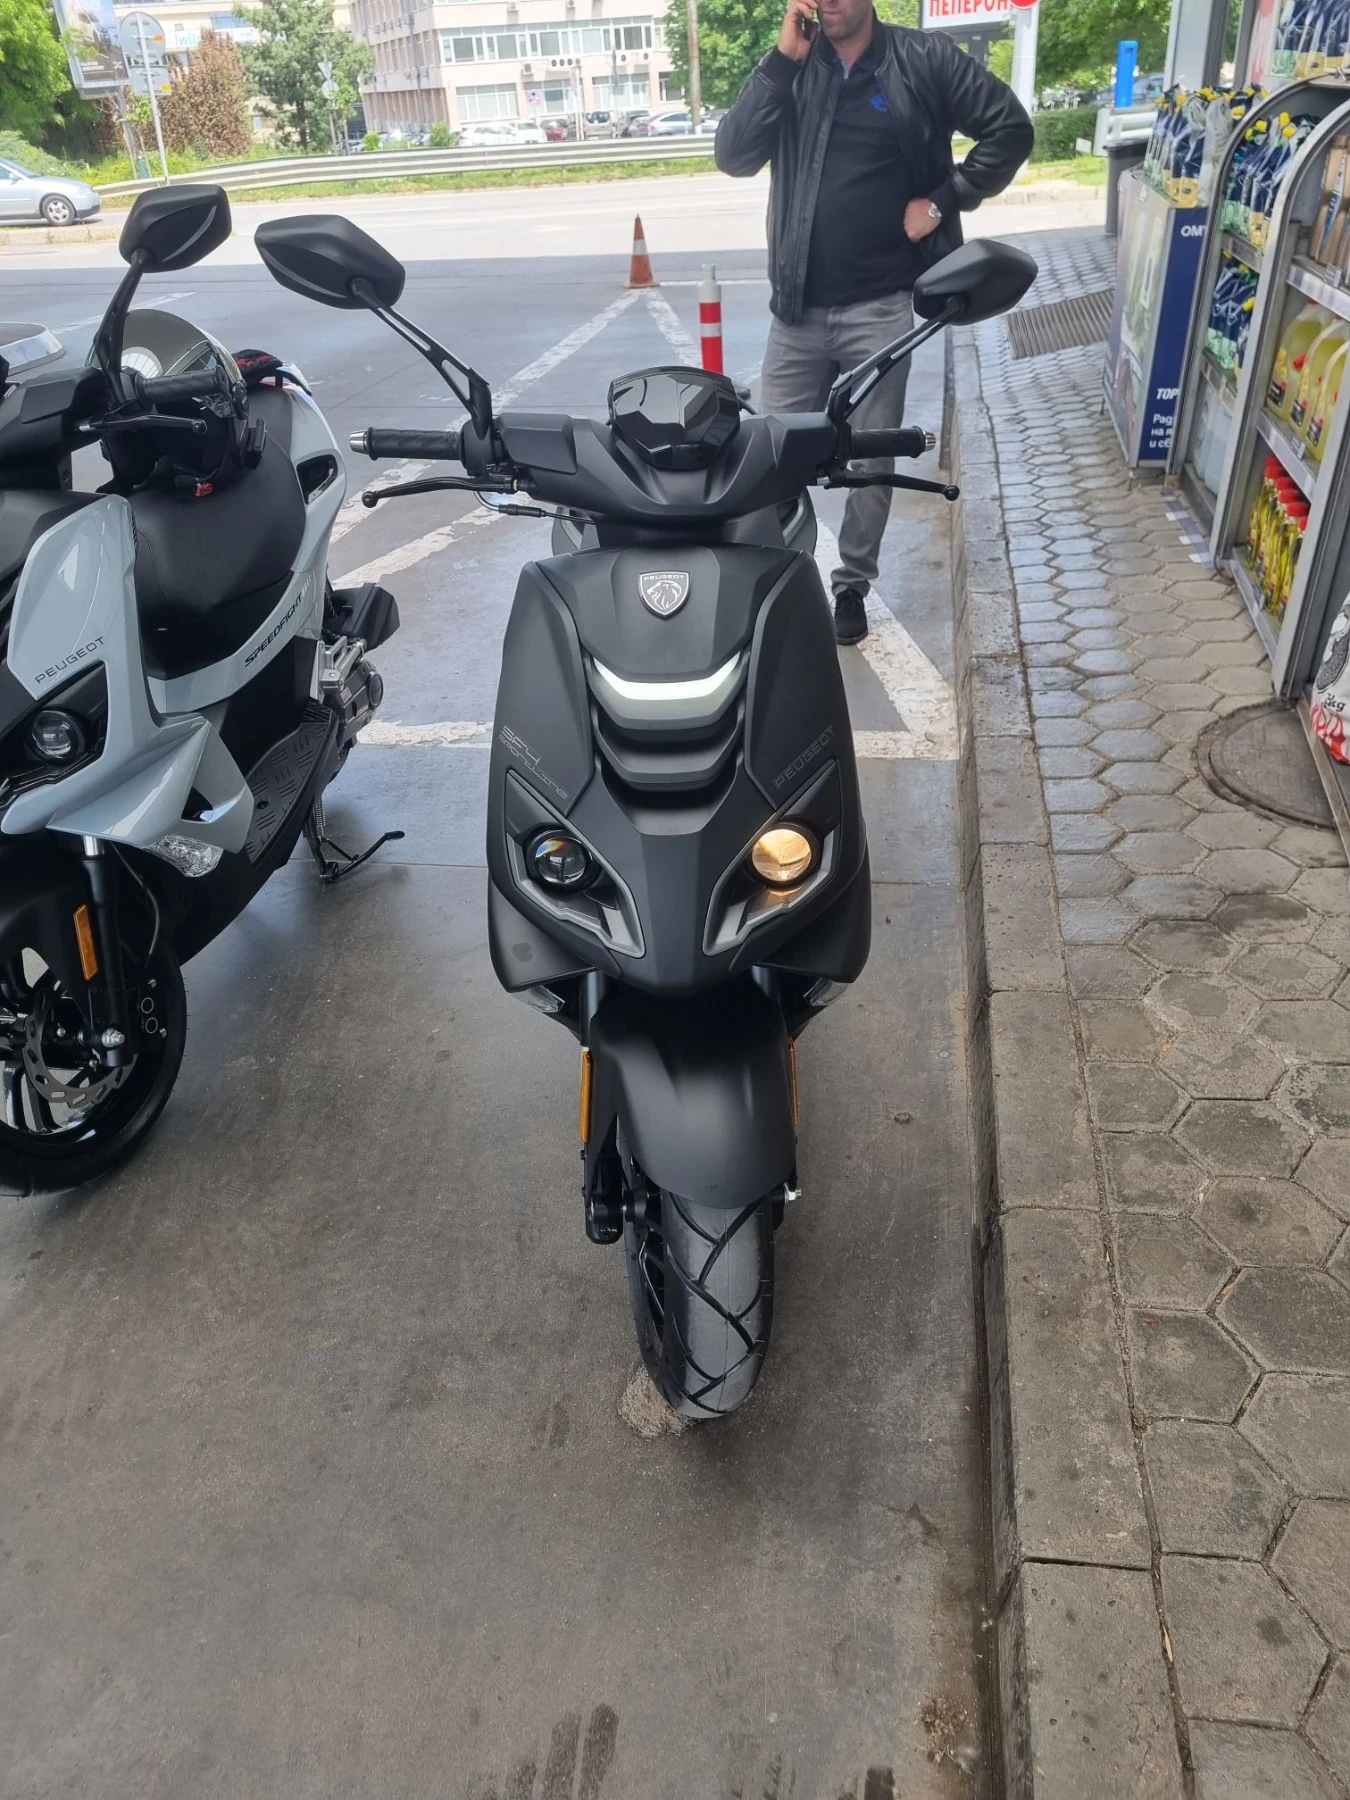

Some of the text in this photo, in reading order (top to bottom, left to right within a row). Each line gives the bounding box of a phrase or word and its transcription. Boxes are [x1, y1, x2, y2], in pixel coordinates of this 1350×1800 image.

[929, 0, 1012, 17] ПЕПЕРОН
[244, 592, 303, 668] SPEEDFIGHT
[34, 636, 105, 684] PEUGEOT
[501, 725, 541, 765] SF4
[773, 724, 835, 790] PEUGEOT
